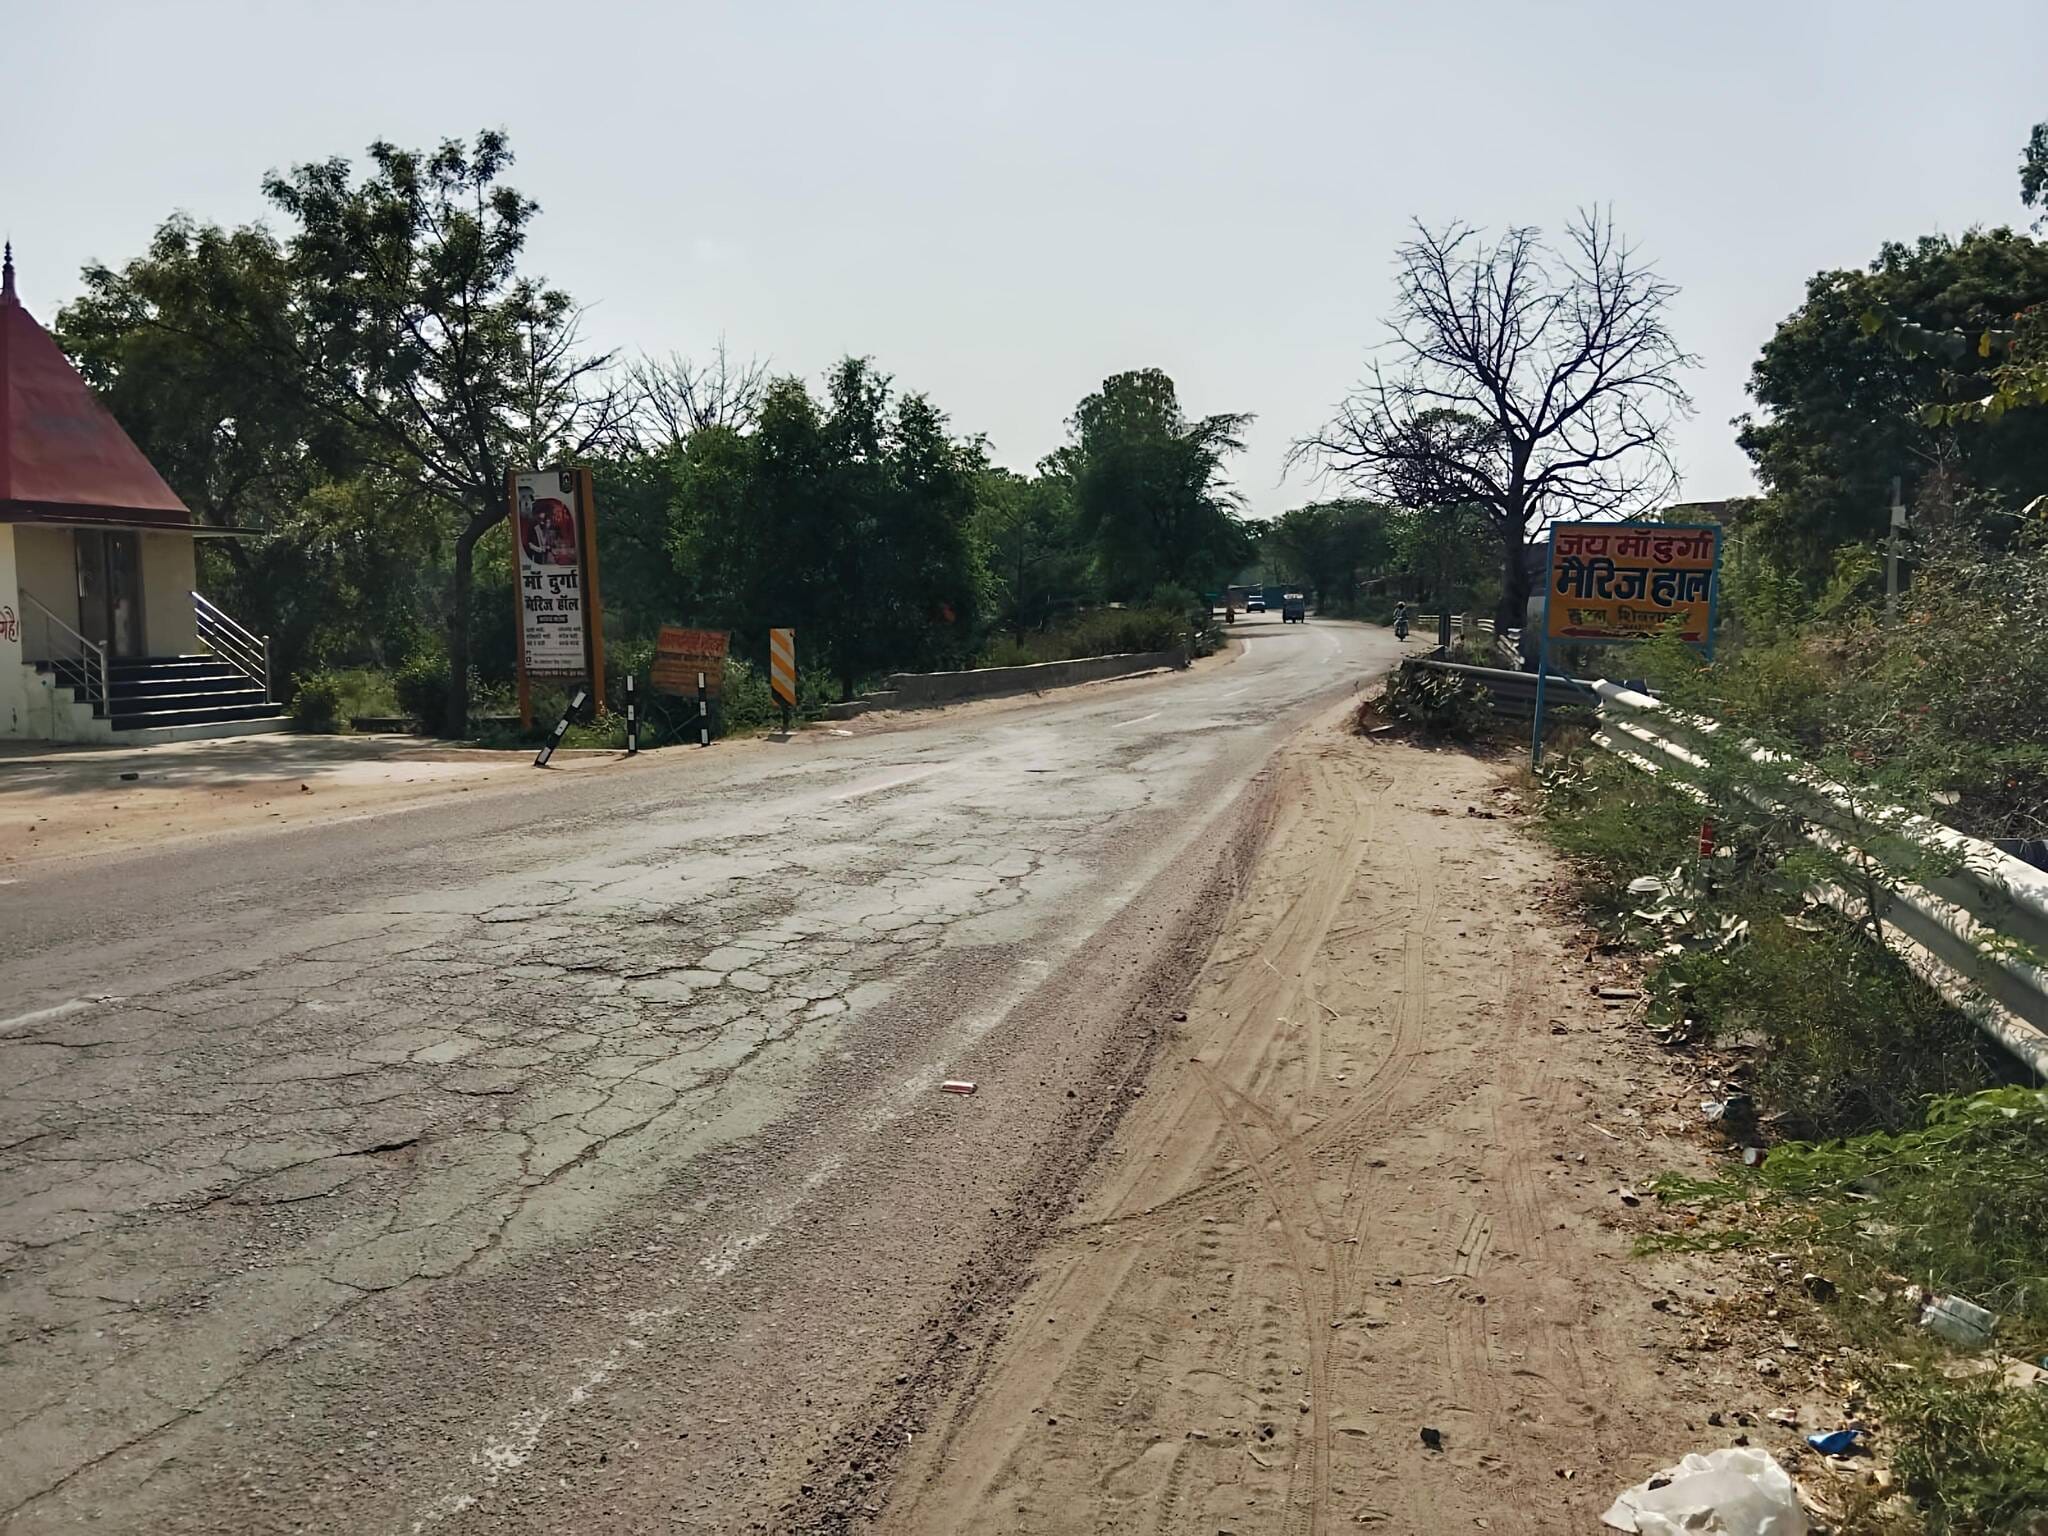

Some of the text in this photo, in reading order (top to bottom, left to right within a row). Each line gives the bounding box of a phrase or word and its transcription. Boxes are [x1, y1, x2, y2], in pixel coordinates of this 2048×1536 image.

[1555, 533, 1610, 556] जय
[547, 569, 578, 594] दुर्गा
[556, 594, 580, 611] हॉल
